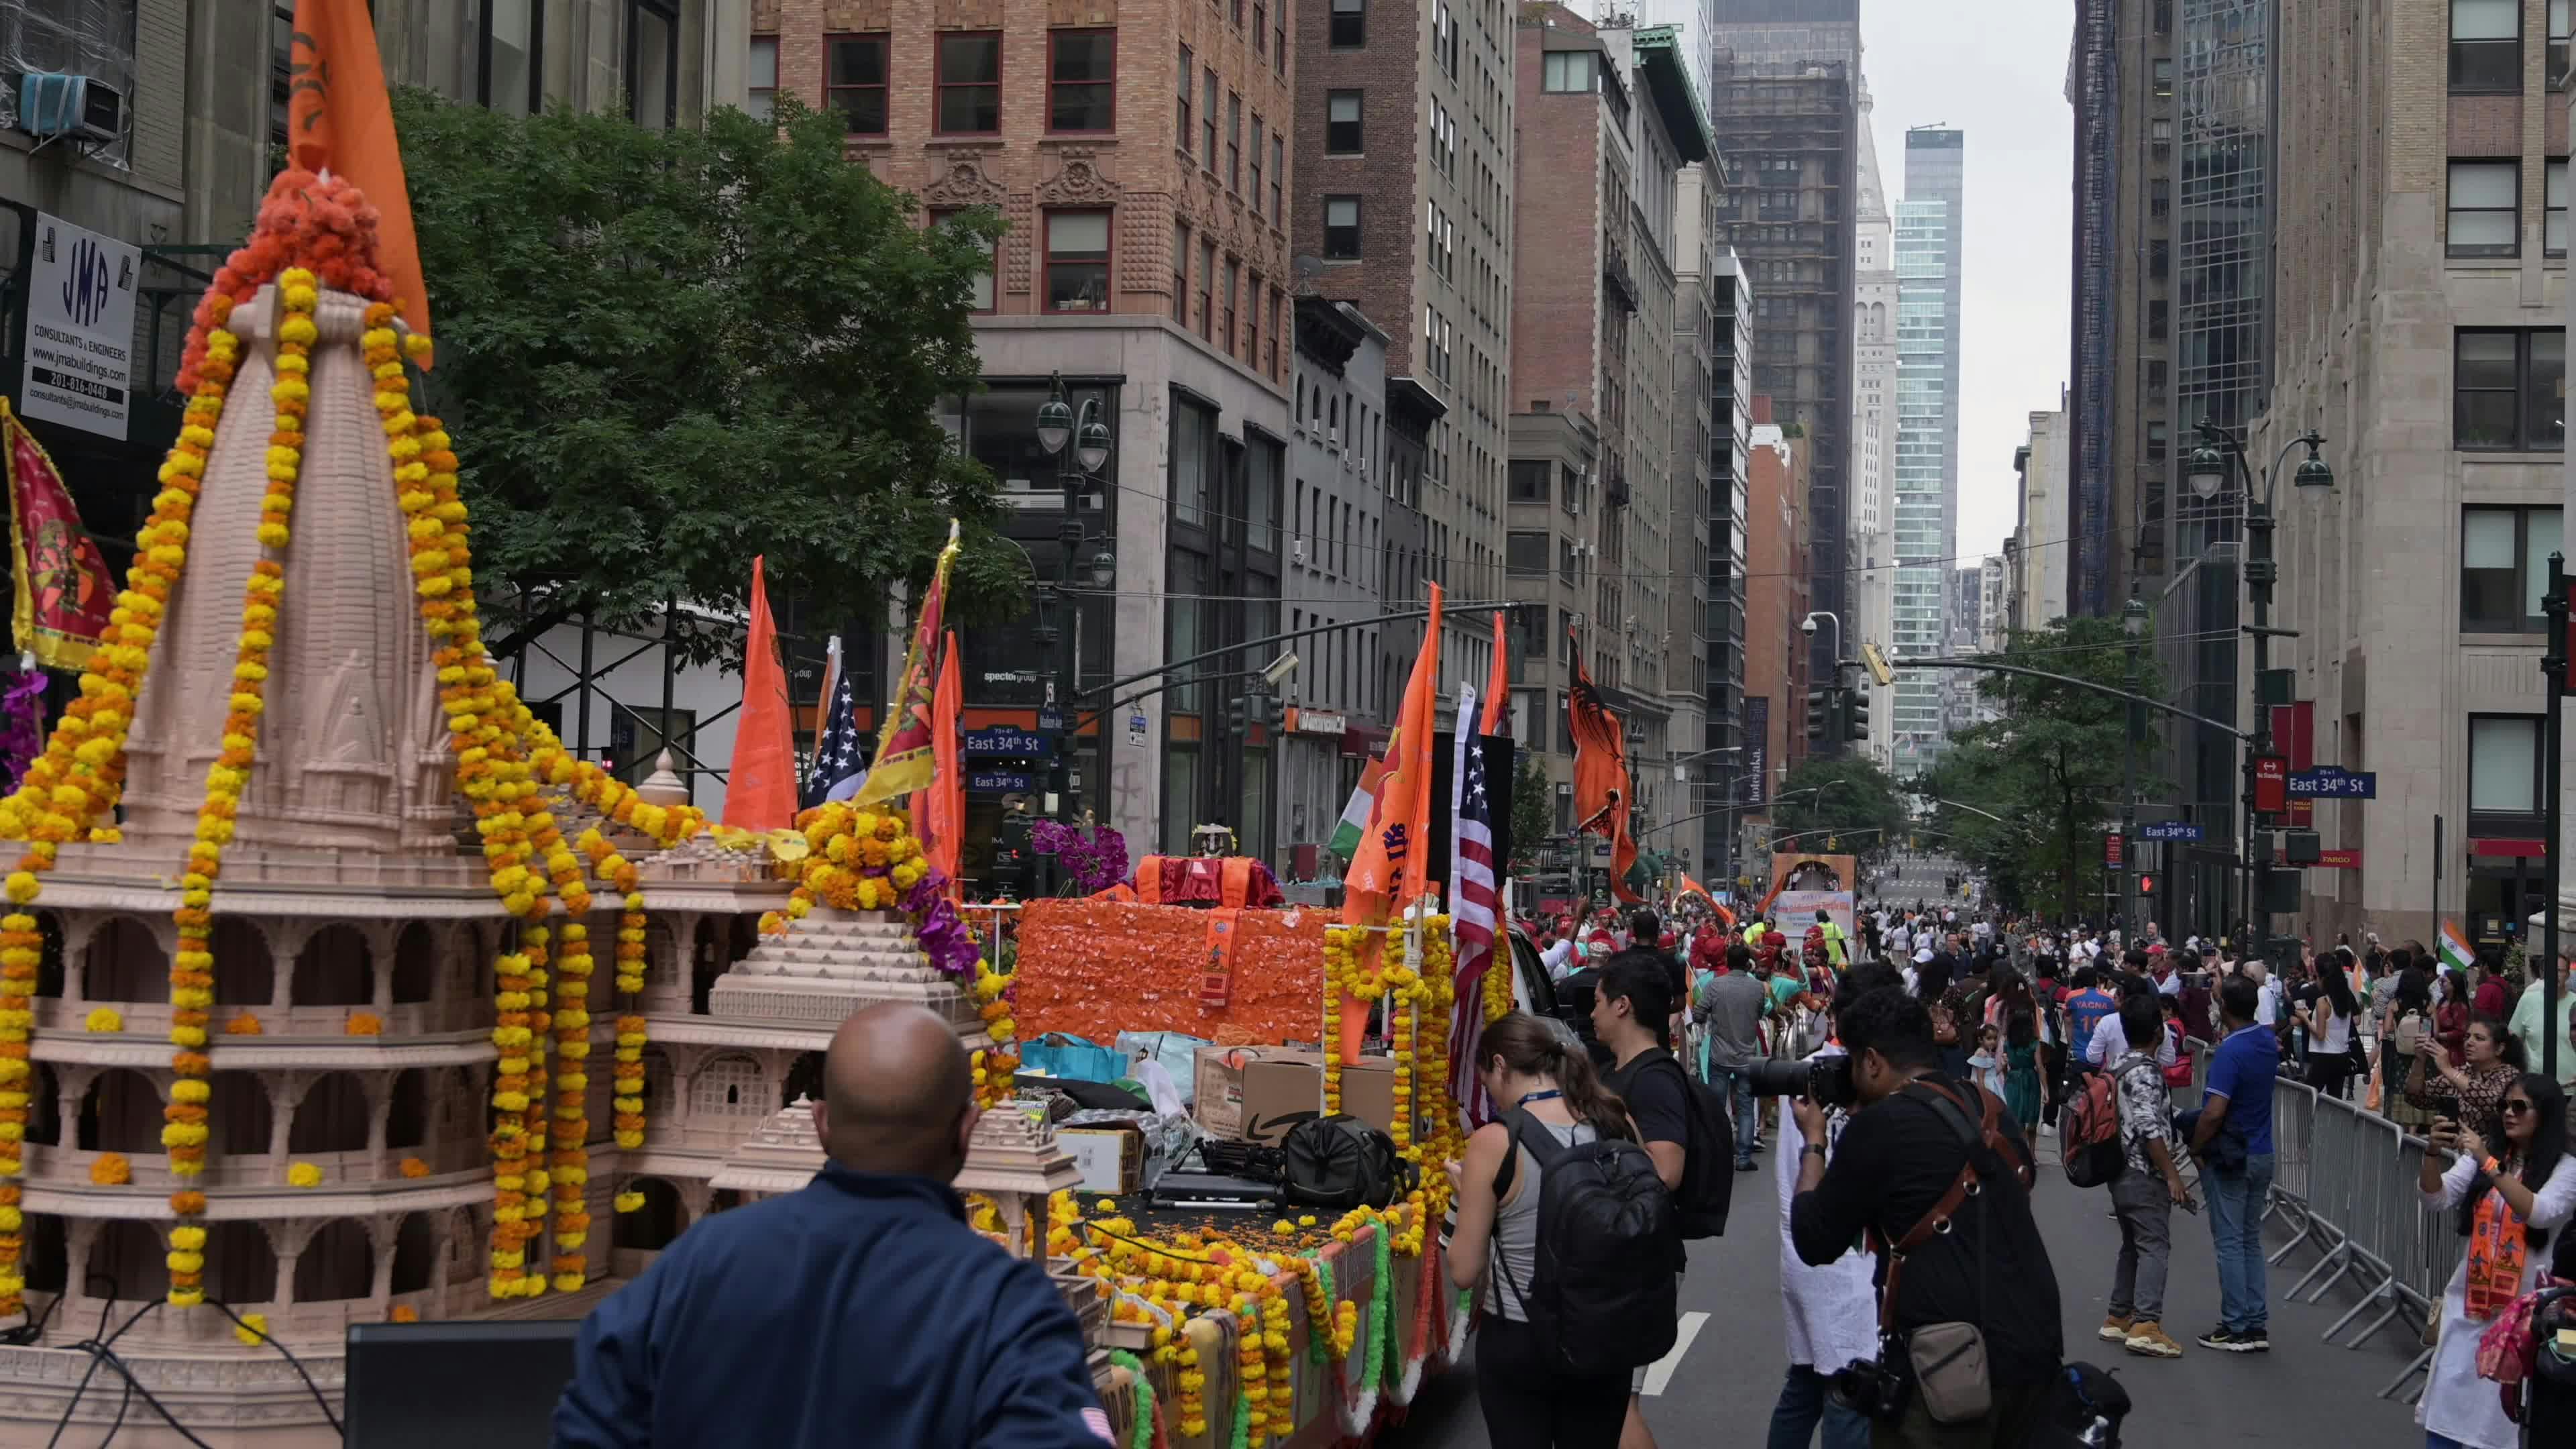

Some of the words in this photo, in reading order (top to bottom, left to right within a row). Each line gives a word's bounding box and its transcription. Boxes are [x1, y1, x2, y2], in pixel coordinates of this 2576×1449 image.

[63, 238, 108, 327] JMA
[34, 324, 83, 350] CONSULTANTS
[89, 341, 126, 362] ENGINEERS
[33, 347, 126, 382] www.jmabuildings.com
[51, 372, 107, 399] 201-816-0448
[30, 388, 124, 420] consultants@jmabuildings.com
[967, 737, 995, 750] East
[998, 736, 1022, 751] 34th
[1025, 737, 1038, 751] St
[975, 777, 994, 787] East
[996, 777, 1012, 788] 34th
[1014, 777, 1024, 788] St
[2263, 773, 2283, 781] Standing
[2290, 777, 2317, 791] East
[2321, 777, 2346, 792] 34th
[2350, 779, 2364, 792] St
[2147, 827, 2165, 837] East
[2167, 827, 2184, 837] 34th
[2186, 828, 2196, 837] St
